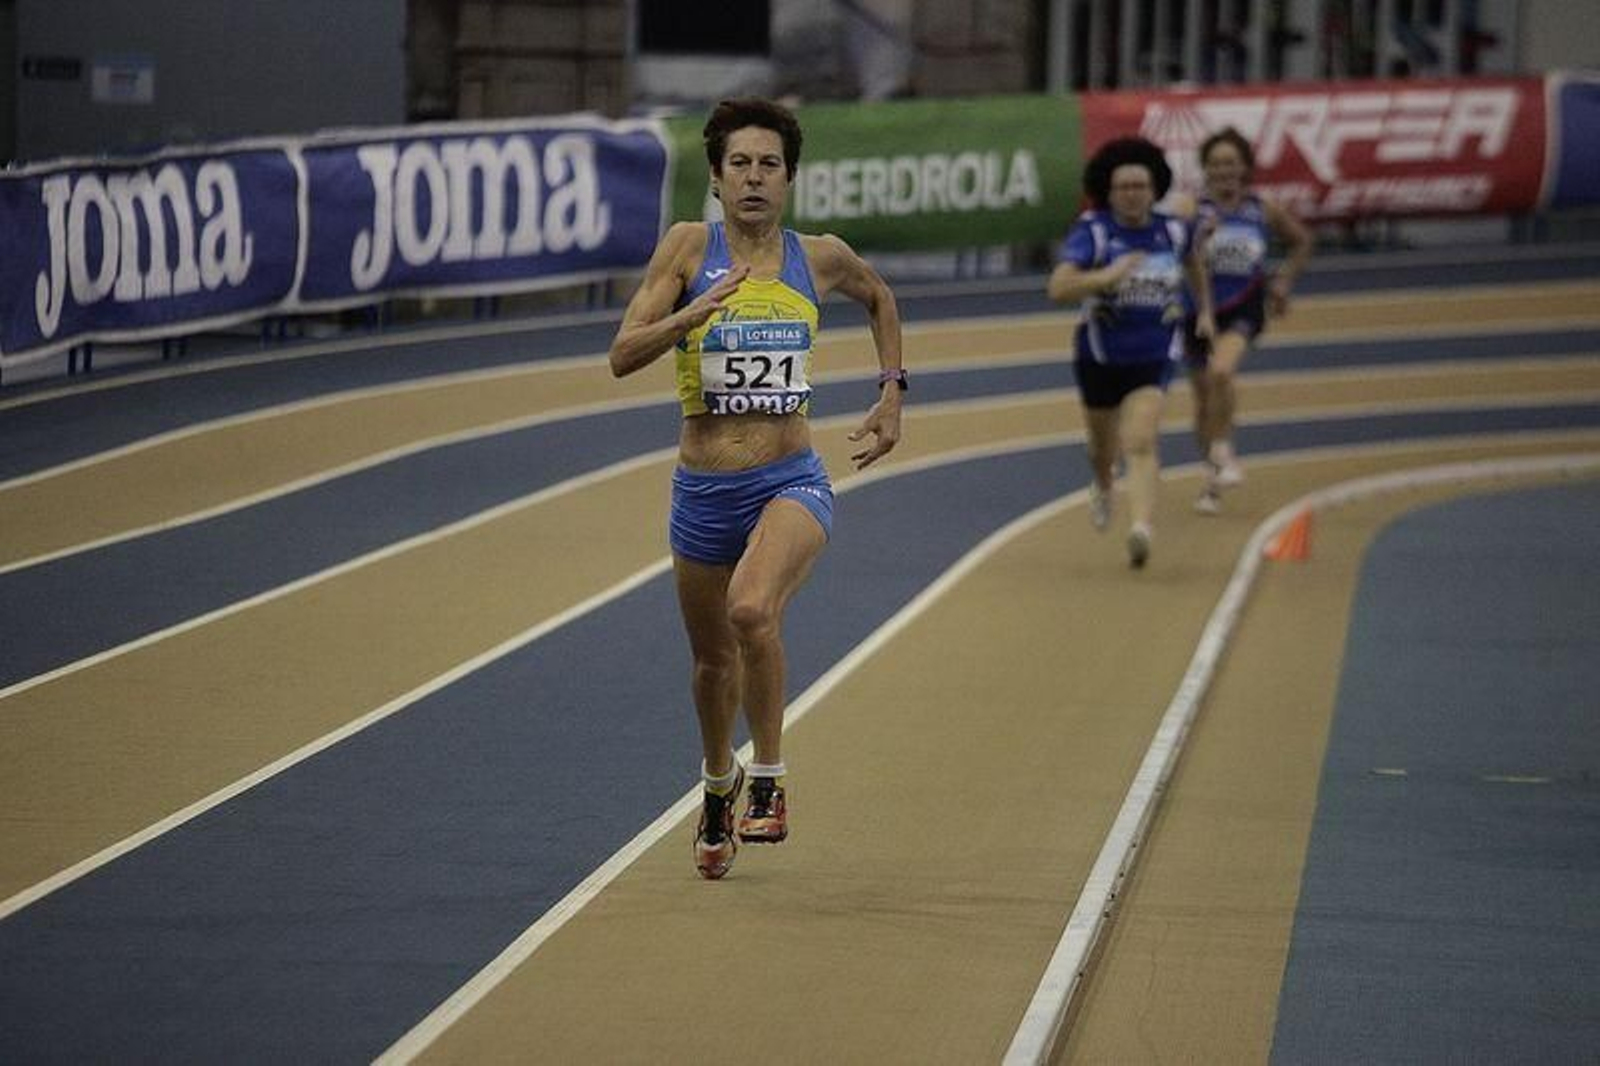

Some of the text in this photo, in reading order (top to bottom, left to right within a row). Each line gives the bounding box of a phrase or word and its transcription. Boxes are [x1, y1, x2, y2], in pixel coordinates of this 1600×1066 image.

[1256, 88, 1515, 183] RFEA
[794, 149, 1043, 222] IBERDROLA
[724, 355, 794, 389] 521
